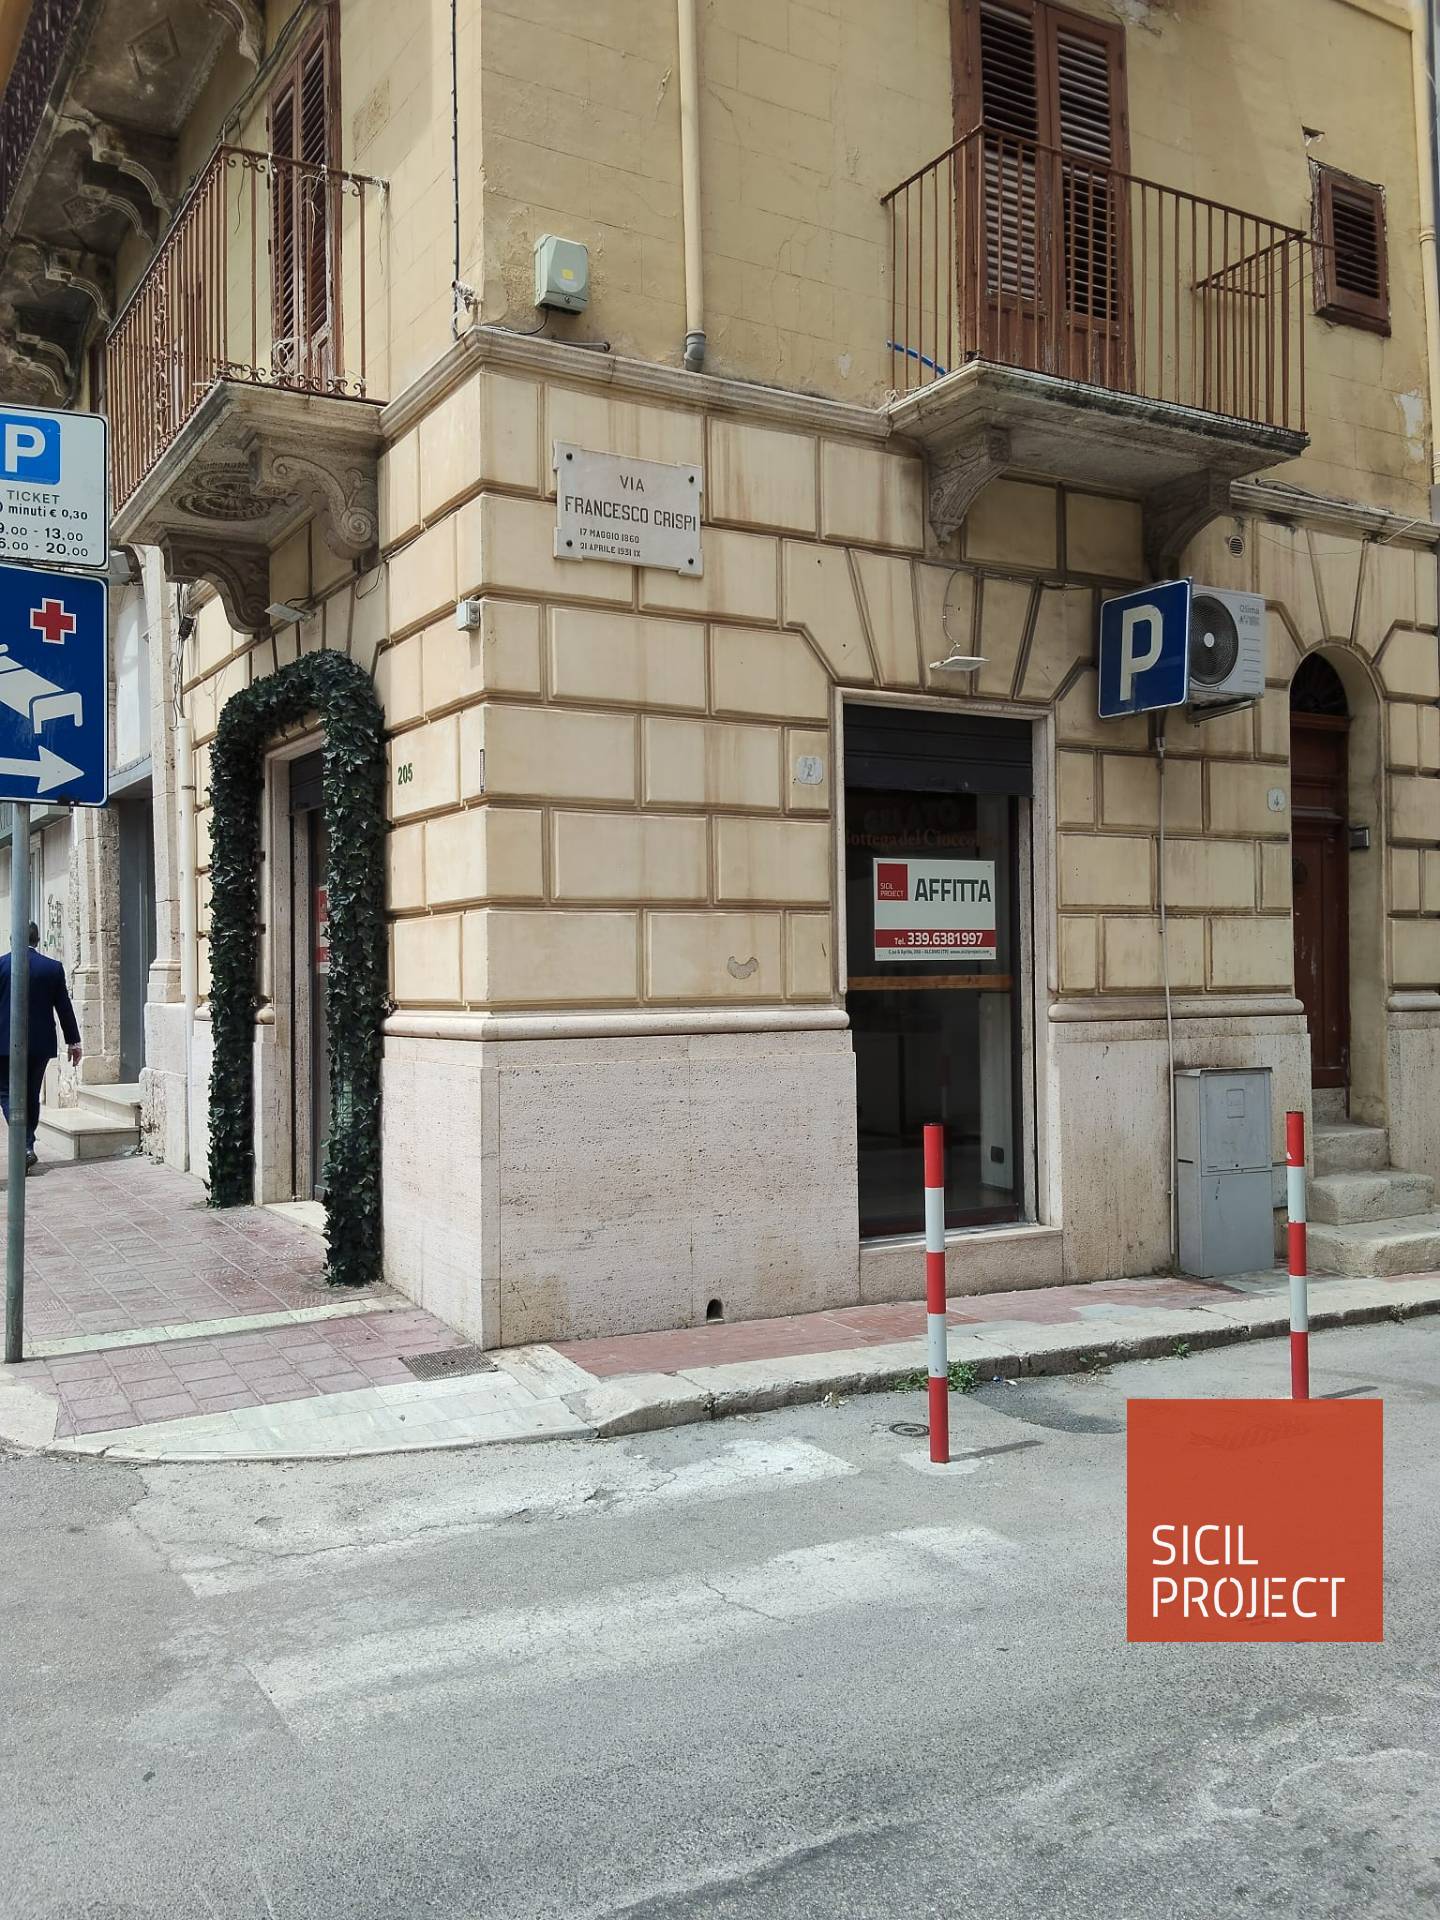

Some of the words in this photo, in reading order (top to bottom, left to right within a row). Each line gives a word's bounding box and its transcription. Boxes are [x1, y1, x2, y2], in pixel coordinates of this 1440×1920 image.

[5, 423, 46, 473] P
[620, 475, 645, 492] VIA
[7, 489, 60, 505] TICKET
[8, 503, 46, 518] minuti
[49, 508, 57, 518] €
[61, 508, 88, 521] 0,30
[565, 495, 649, 524] FRANCESCO
[654, 509, 696, 532] CRISPI
[45, 527, 83, 542] 13.00
[580, 528, 587, 536] 17
[589, 528, 619, 541] MAGGIO
[621, 533, 640, 544] 1860
[46, 542, 88, 557] 20.00
[580, 542, 587, 550] 21
[589, 543, 616, 554] APRILE
[633, 548, 641, 557] IX
[1119, 604, 1164, 702] P
[397, 762, 413, 785] 205
[914, 878, 992, 903] AFFITTA
[907, 932, 983, 945] 339.6381997
